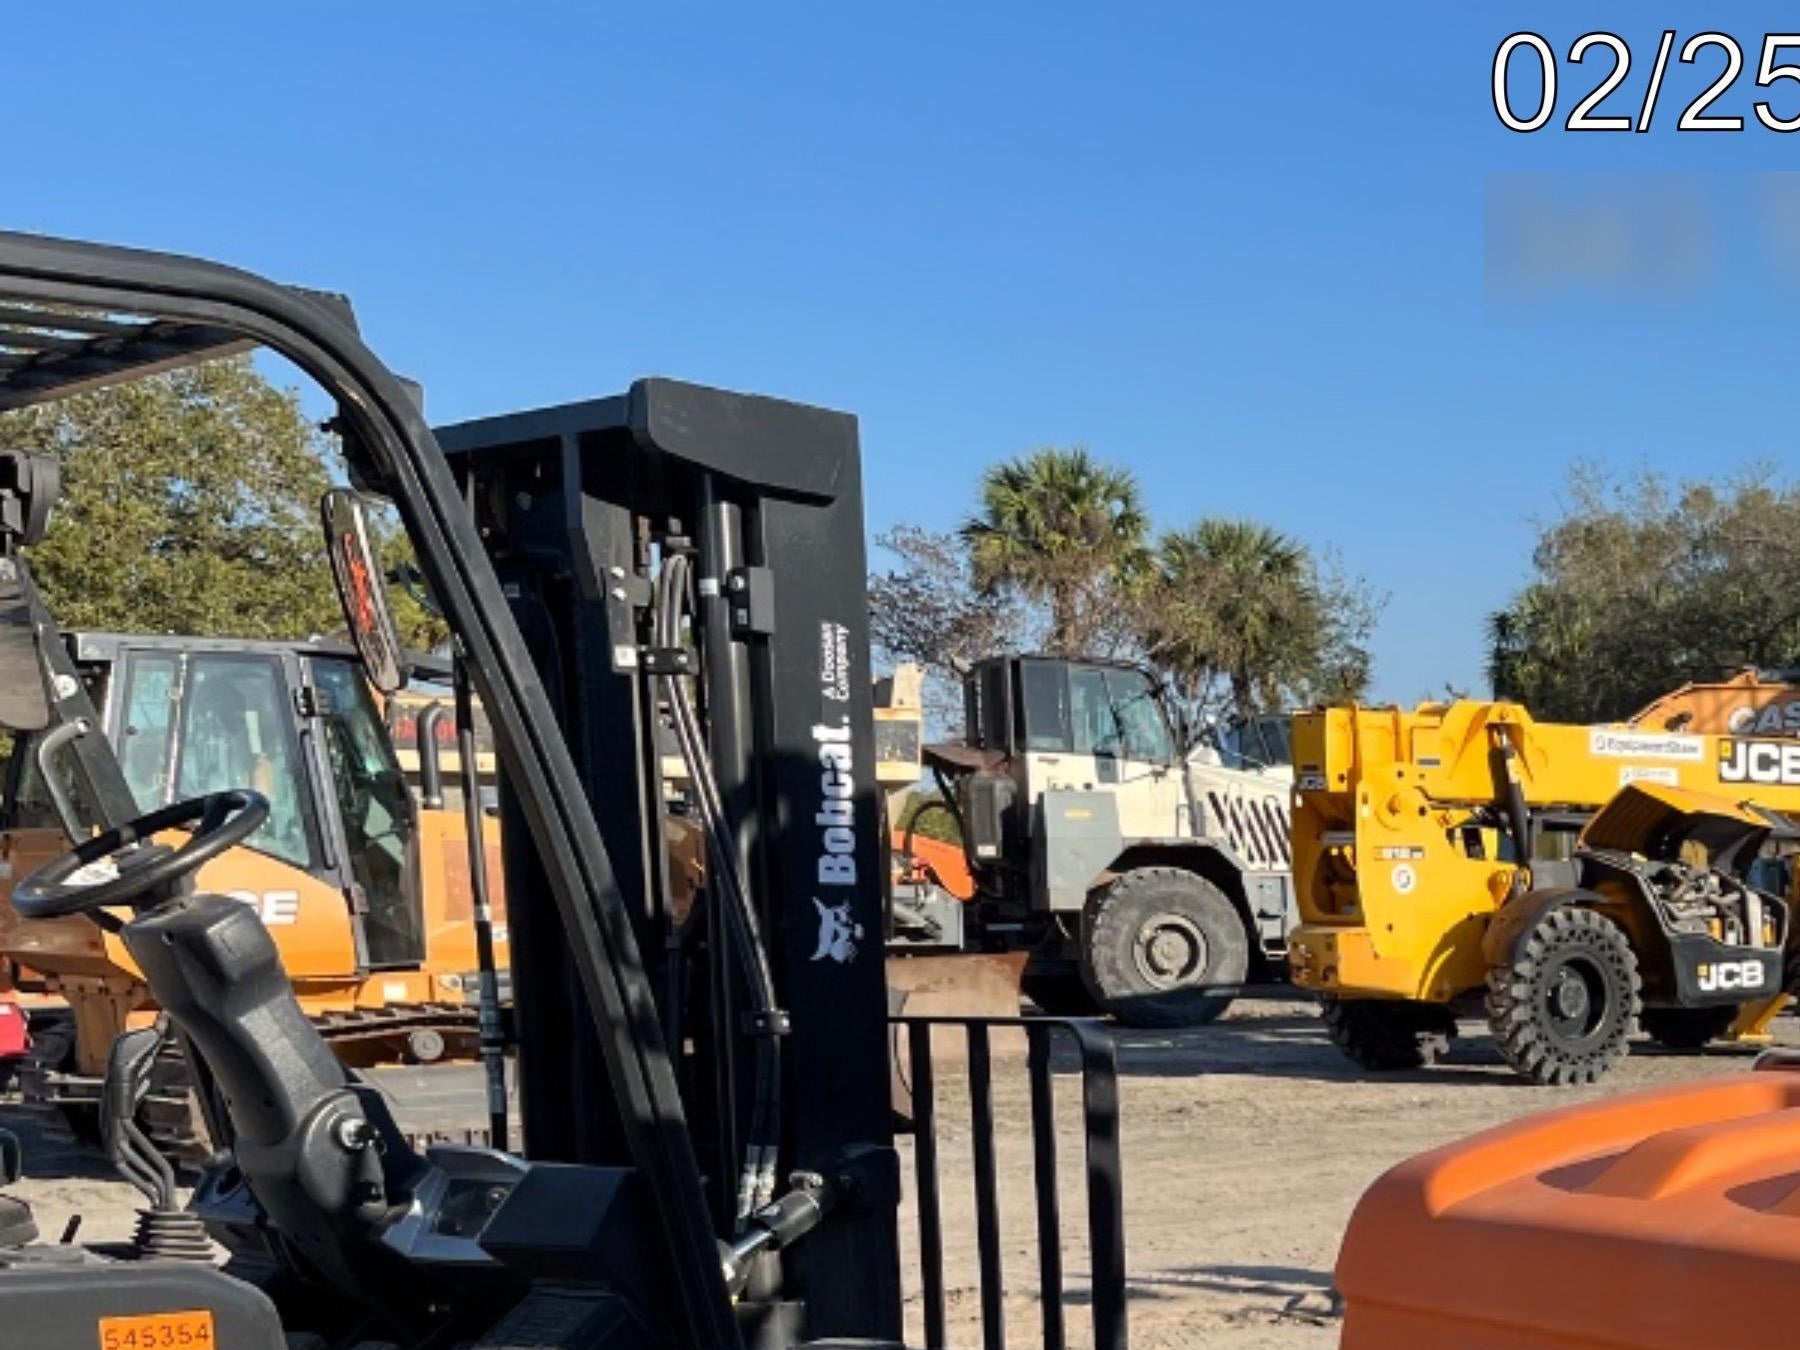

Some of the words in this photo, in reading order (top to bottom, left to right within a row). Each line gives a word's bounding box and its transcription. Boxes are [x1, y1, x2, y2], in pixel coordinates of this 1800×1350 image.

[836, 623, 850, 702] Company
[1697, 960, 1764, 991] JCB
[105, 1323, 210, 1350] 545354
